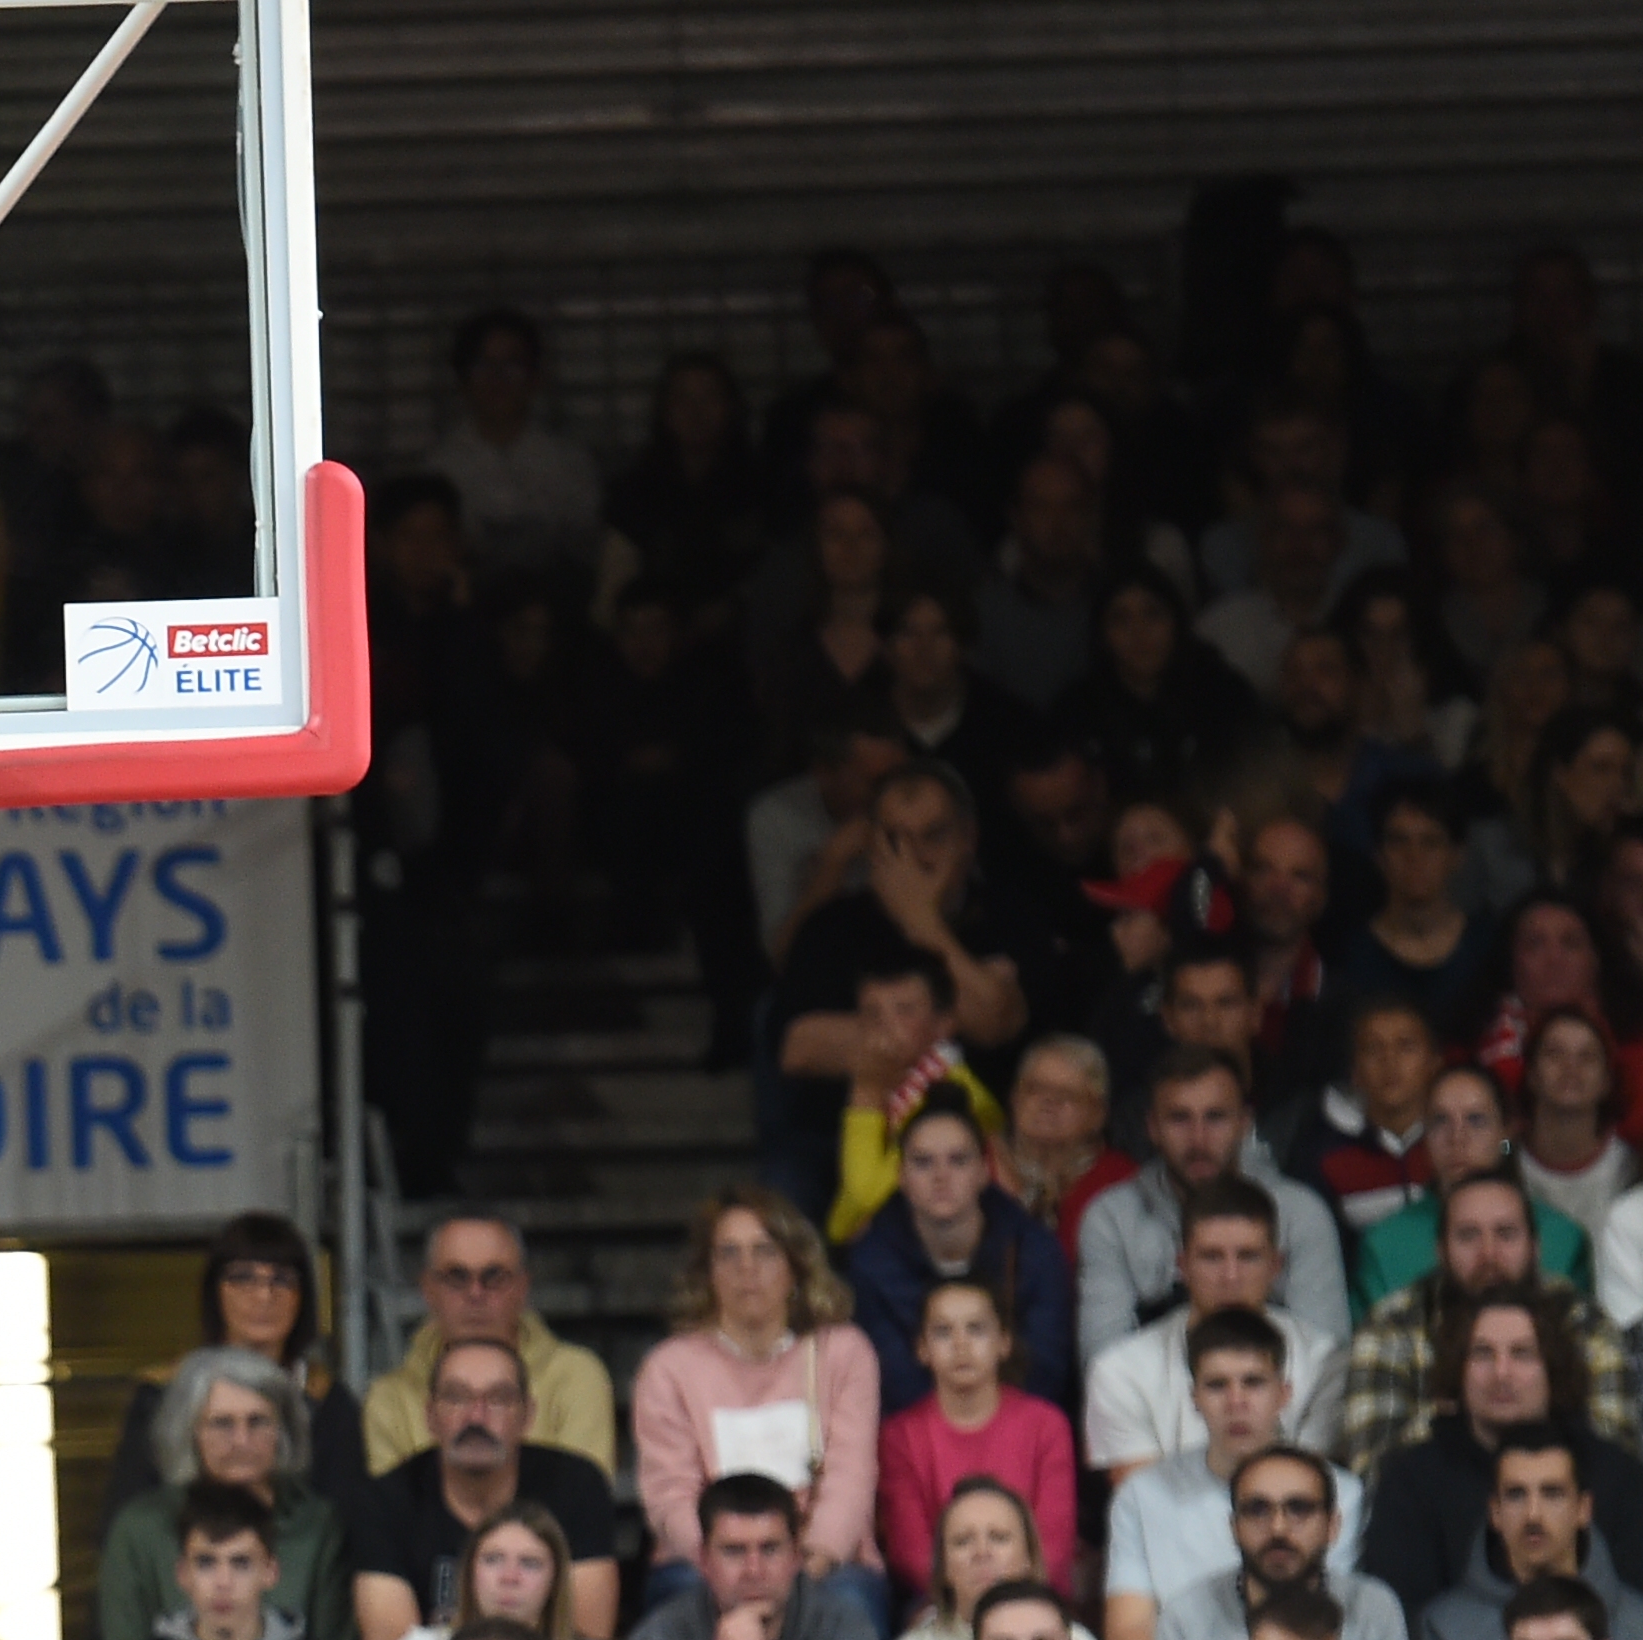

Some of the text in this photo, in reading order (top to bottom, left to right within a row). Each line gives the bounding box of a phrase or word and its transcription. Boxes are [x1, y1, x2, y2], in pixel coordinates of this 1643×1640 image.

[172, 628, 263, 655] Betclic
[176, 663, 262, 694] ÉLITE
[86, 978, 233, 1035] de la
